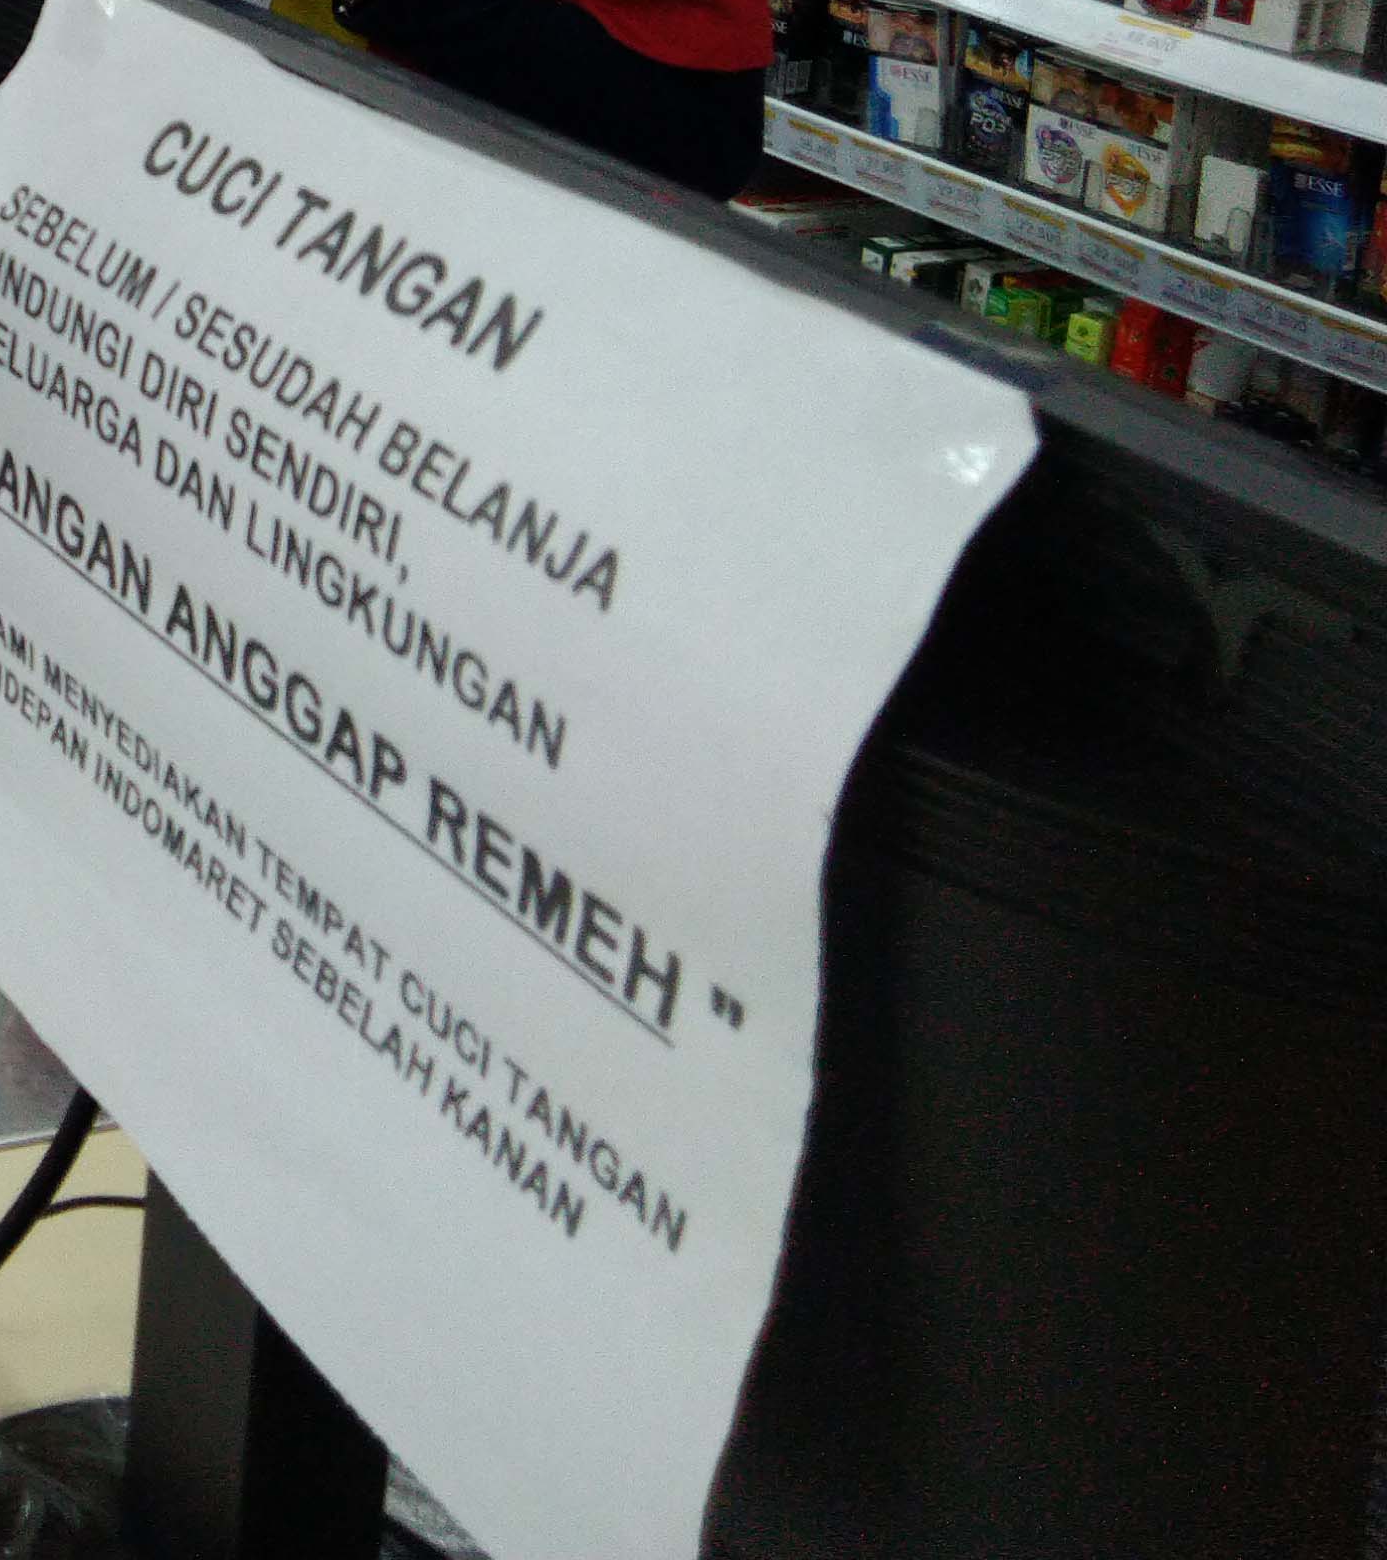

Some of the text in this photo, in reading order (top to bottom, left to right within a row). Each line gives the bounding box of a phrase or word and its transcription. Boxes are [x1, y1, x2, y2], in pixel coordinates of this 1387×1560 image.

[901, 69, 932, 83] ESSE
[1308, 176, 1346, 197] ESSE
[0, 184, 620, 614] SEBELUM / SESUDAH BELANJA
[143, 117, 545, 373] CUCI TANGAN
[138, 349, 218, 439] DIRI
[227, 408, 409, 585] SENDIRI,
[154, 440, 236, 532] DAN
[246, 499, 568, 772] LINGKUNGAN
[43, 652, 248, 860] MENYEDIAKAN
[256, 835, 393, 983] TEMPAT
[400, 971, 492, 1080] CUCI
[504, 1055, 689, 1254] TANGAN
[165, 584, 409, 800] ANGGAP
[427, 773, 681, 1032] REMEH
[93, 760, 267, 933] INDOMARET
[272, 918, 435, 1097] SEBELAH
[440, 1078, 585, 1240] KANAN
